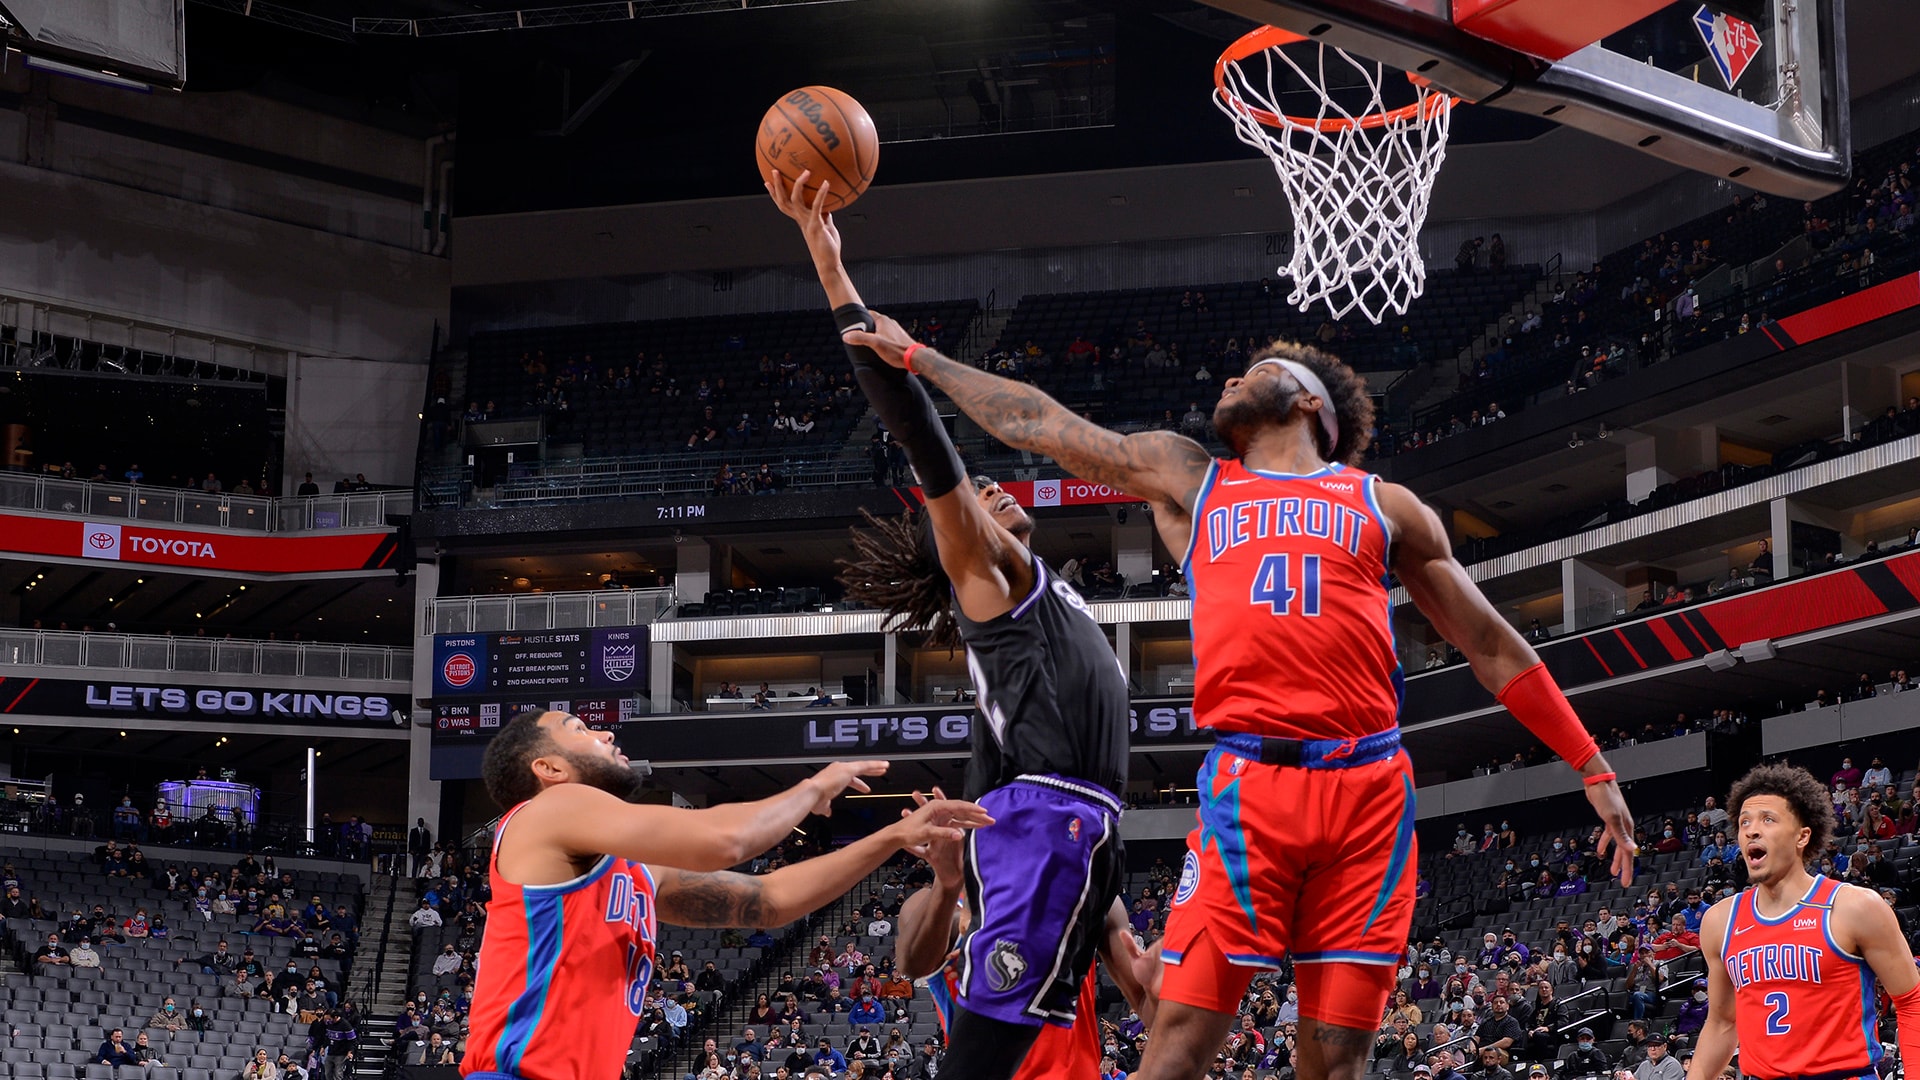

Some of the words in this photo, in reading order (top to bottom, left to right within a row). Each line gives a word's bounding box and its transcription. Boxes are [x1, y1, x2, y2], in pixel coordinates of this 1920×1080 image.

[1733, 22, 1746, 49] 75
[786, 90, 841, 153] Wilson
[1266, 233, 1288, 255] 202
[1067, 484, 1123, 498] TOYO
[1320, 481, 1354, 492] UWM
[657, 506, 682, 519] 7:11
[687, 505, 705, 518] PM
[1207, 497, 1368, 563] DETROIT
[129, 536, 216, 559] TOYOTA
[1250, 553, 1321, 616] 41
[445, 639, 476, 647] PISTONS
[524, 636, 554, 644] HUSTLE
[555, 634, 580, 643] STATS
[530, 651, 563, 659] REBOUNDS
[605, 660, 634, 668] KINGS
[86, 685, 186, 709] LETS
[195, 689, 253, 712] GO
[263, 692, 389, 717] KINGS
[589, 701, 606, 710] CLE
[451, 706, 470, 715] BKN
[484, 705, 497, 713] 119
[589, 713, 604, 721] CHI
[451, 718, 471, 726] WAS
[483, 717, 497, 725] 118
[1149, 707, 1213, 732] ST
[809, 716, 929, 743] LET'S
[940, 715, 972, 739] G
[373, 831, 408, 840] ernar
[1793, 918, 1817, 928] UWM
[1726, 944, 1823, 993] DETROIT
[624, 941, 652, 1017] 18
[1764, 992, 1791, 1036] 2
